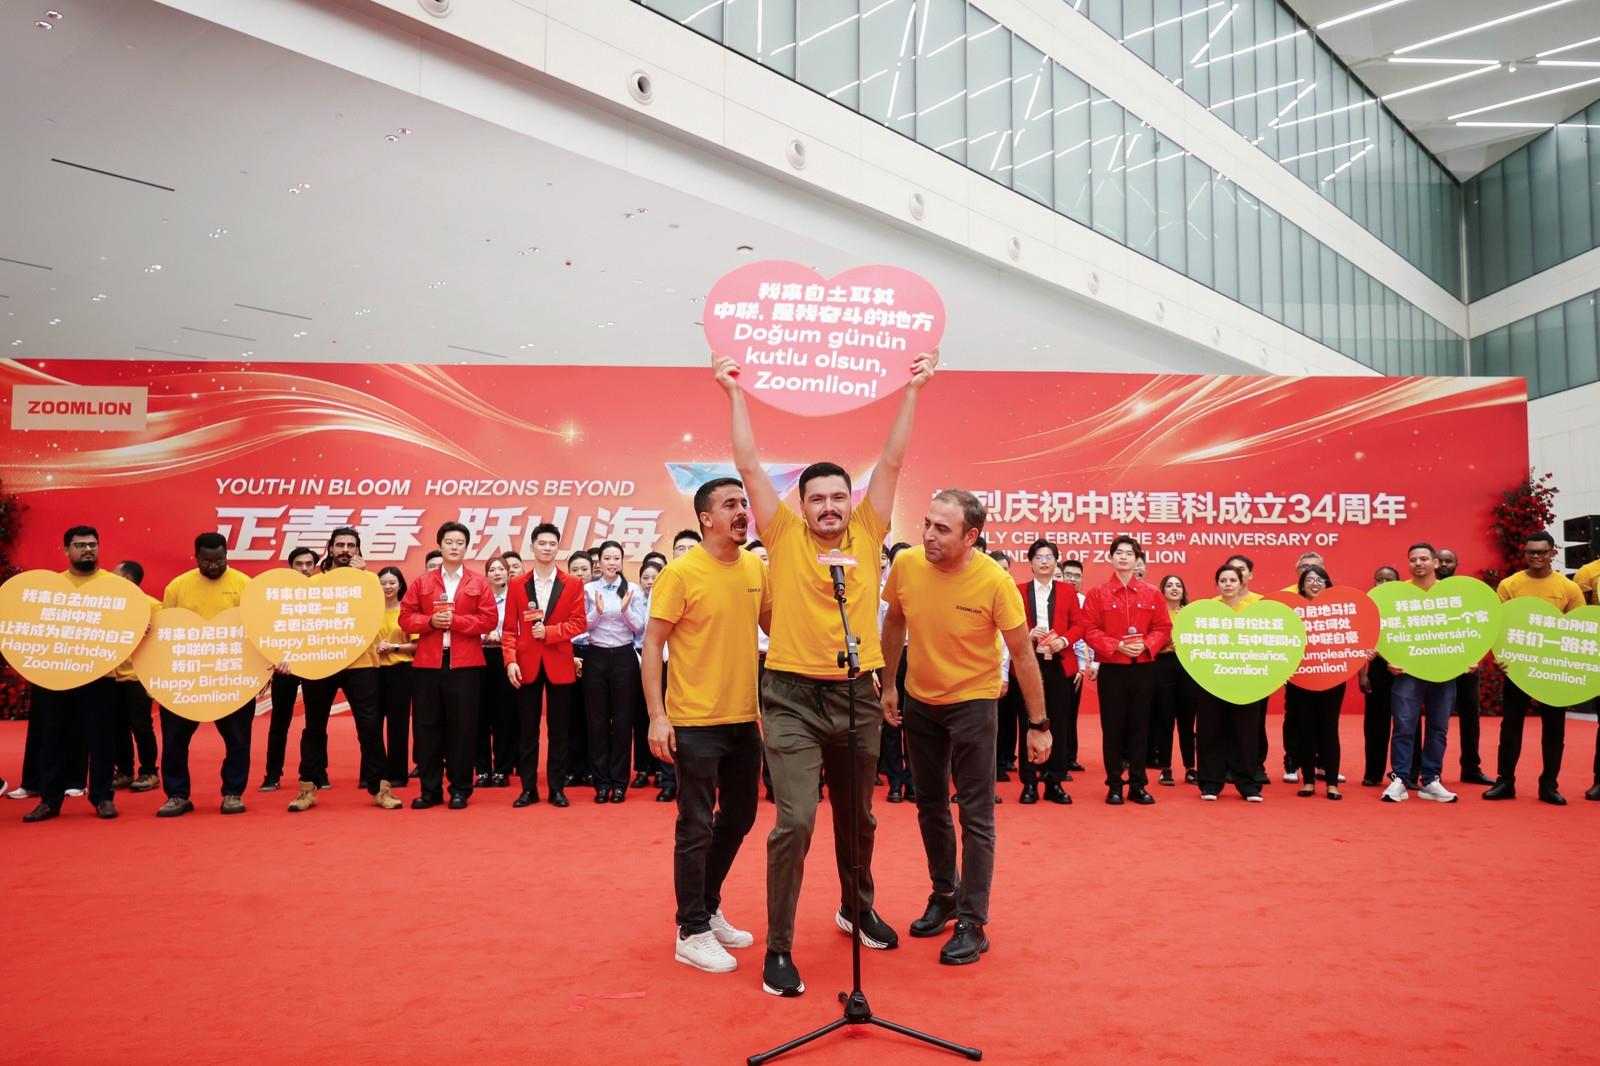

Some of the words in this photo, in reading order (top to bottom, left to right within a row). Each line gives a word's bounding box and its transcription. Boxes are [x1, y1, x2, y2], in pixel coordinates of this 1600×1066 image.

[758, 283, 895, 305] 我来自土耳其
[734, 324, 821, 345] Doğum
[828, 328, 907, 350] günün
[745, 347, 807, 366] kutlu
[815, 351, 887, 378] olsun,
[754, 371, 878, 398] Zoomlion!
[27, 401, 132, 416] ZOOMLION
[215, 478, 296, 495] YOUTH
[300, 479, 325, 495] IN
[328, 479, 411, 496] BLOOM
[425, 479, 539, 496] HORIZONS
[543, 480, 635, 497] BEYOND
[931, 490, 1407, 525] 烈庆祝中联重科成立34周年
[215, 504, 426, 561] 正青春
[457, 506, 664, 561] 跃山海
[1156, 532, 1186, 545] 34th
[1189, 533, 1314, 546] ANNIVERSARY
[1316, 533, 1339, 546] OF
[1066, 550, 1089, 562] OF
[22, 588, 127, 610] 我来自孟加拉国
[265, 586, 362, 601] 我来自巴基斯坦
[280, 602, 349, 616] 与中联一起
[1395, 596, 1462, 612] 我来自巴西
[40, 607, 102, 624] 感谢中联
[1195, 617, 1284, 630] 我来自哥伦比亚
[0, 621, 136, 644] 让我成为更好的自己
[273, 617, 356, 632] 去更远的地方
[157, 626, 248, 641] 我来自尼日利
[259, 636, 304, 649] Happy
[308, 634, 366, 647] Birthday,
[1386, 632, 1412, 644] Feliz
[1414, 628, 1481, 642] aniversário,
[1, 638, 50, 655] Happy
[53, 643, 118, 662] Birthday,
[172, 642, 243, 657] 中联的未来
[1408, 643, 1465, 656] Zoomlion!
[1507, 628, 1600, 656] 我们一路并
[282, 648, 347, 663] Zoomlion!
[1190, 648, 1217, 662] ¡Feliz
[1219, 650, 1289, 664] cumpleaños,
[1498, 648, 1539, 663] Joyeux
[22, 656, 95, 673] Zoomlion!
[171, 658, 243, 673] 我们一起写
[1213, 663, 1268, 676] Zoomlion!
[1294, 662, 1348, 674] oomlion!
[149, 677, 196, 691] Happy
[199, 674, 260, 688] Birthday,
[1528, 667, 1587, 685] Zoomlion!
[172, 689, 240, 705] Zoomlion!
